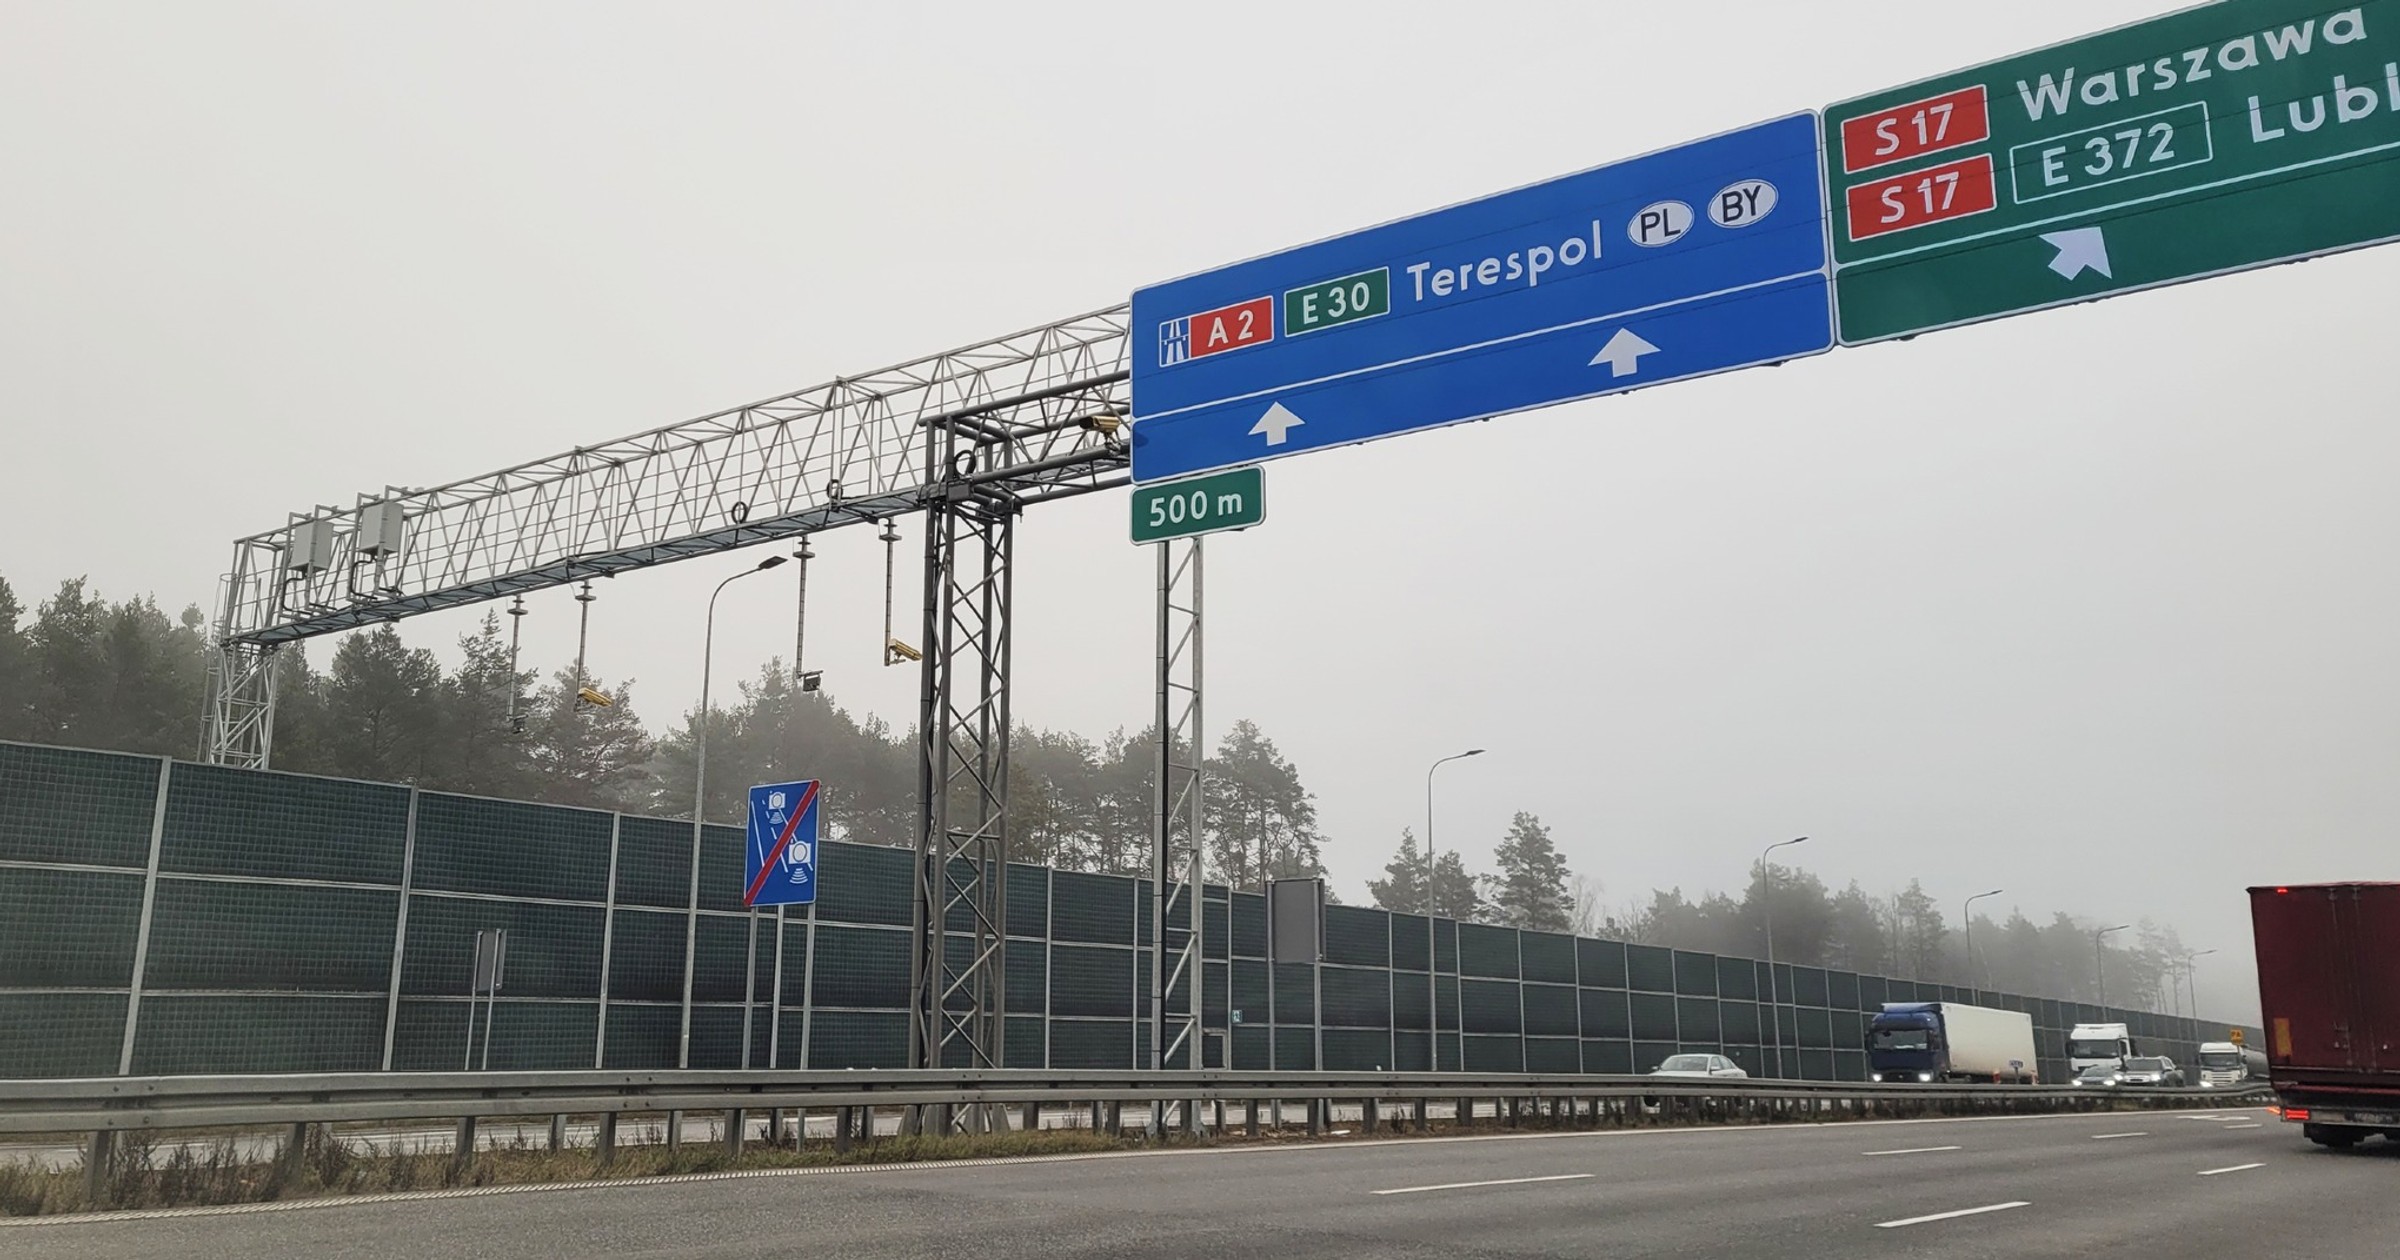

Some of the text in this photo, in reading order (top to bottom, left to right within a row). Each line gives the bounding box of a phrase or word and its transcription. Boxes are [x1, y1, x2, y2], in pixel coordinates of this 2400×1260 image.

[2016, 8, 2367, 121] Warszawa
[1875, 102, 1953, 156] S 17
[2248, 62, 2400, 143] Lubl
[2042, 122, 2174, 186] E 372
[1722, 184, 1762, 223] BY
[1880, 171, 1959, 224] S 17
[1640, 208, 1681, 243] PL
[1406, 220, 1602, 301] Terespol
[1207, 309, 1254, 348] A 2
[1303, 282, 1370, 325] E 30
[1149, 490, 1242, 527] 500 m
